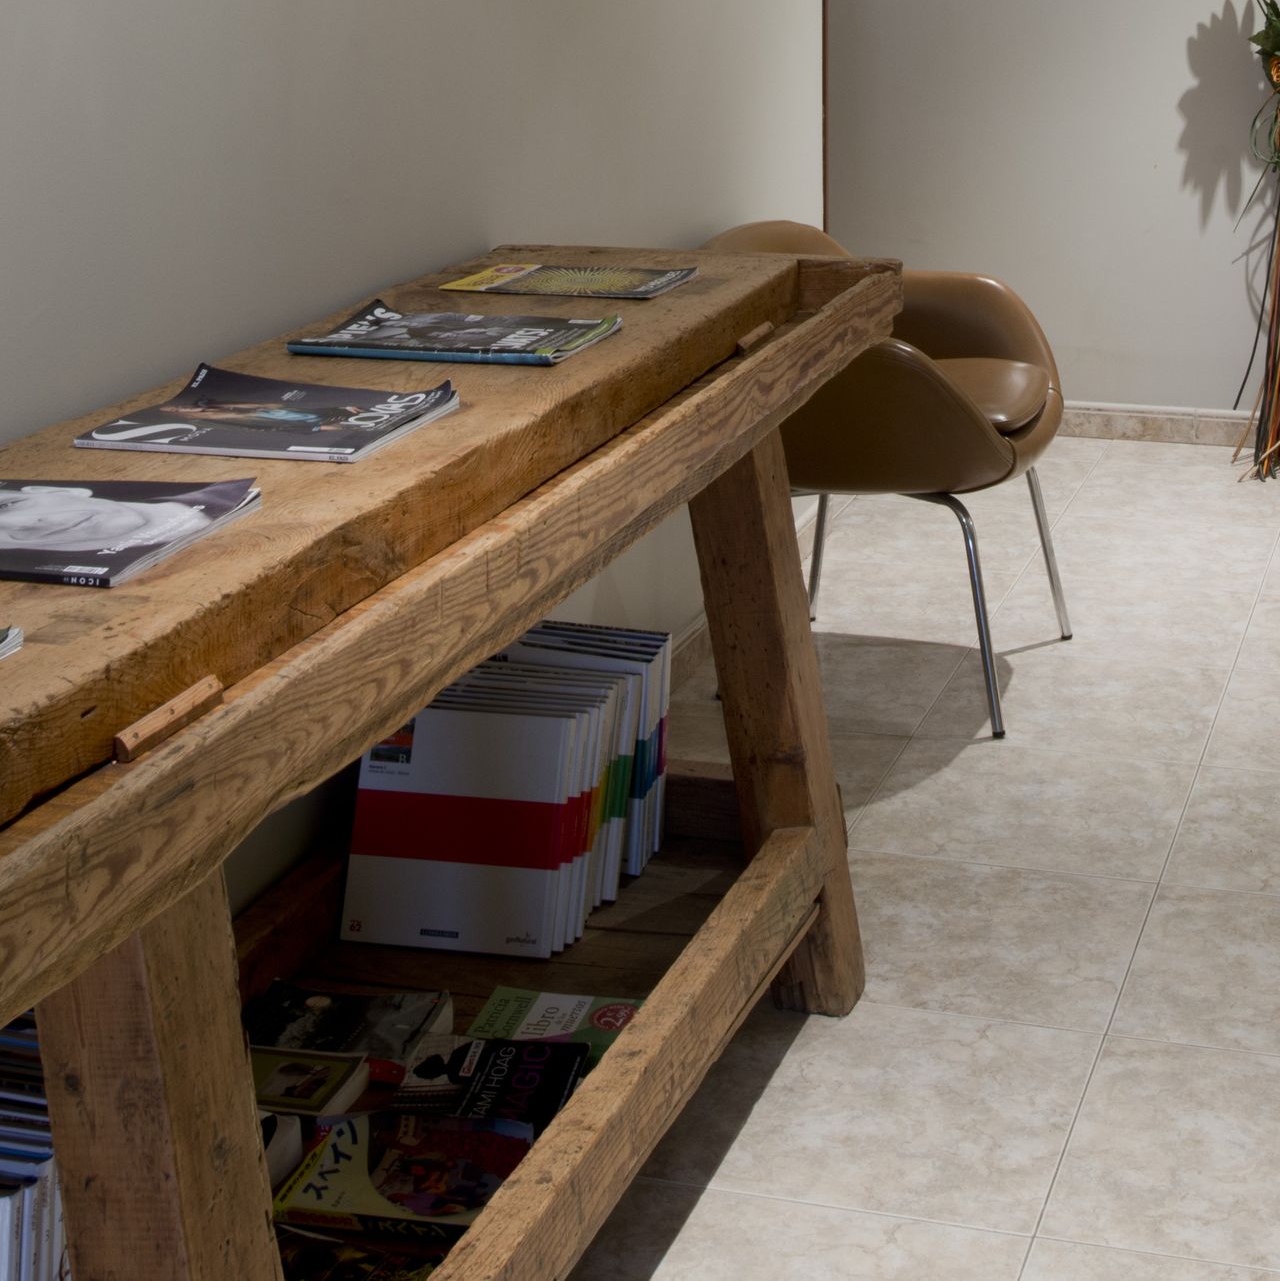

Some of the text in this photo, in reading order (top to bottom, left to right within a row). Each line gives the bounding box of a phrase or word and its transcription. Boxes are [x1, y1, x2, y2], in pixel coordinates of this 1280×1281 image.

[340, 393, 426, 428] JOYAS
[91, 419, 197, 444] S
[70, 577, 100, 587] ICON
[474, 998, 510, 1033] Patricia
[491, 996, 532, 1039] Cornwell
[521, 1006, 560, 1036] libro
[560, 999, 587, 1031] muertos
[467, 1091, 496, 1119] TAMI
[486, 1046, 516, 1089] HOAG
[302, 1118, 358, 1200] スペイン
